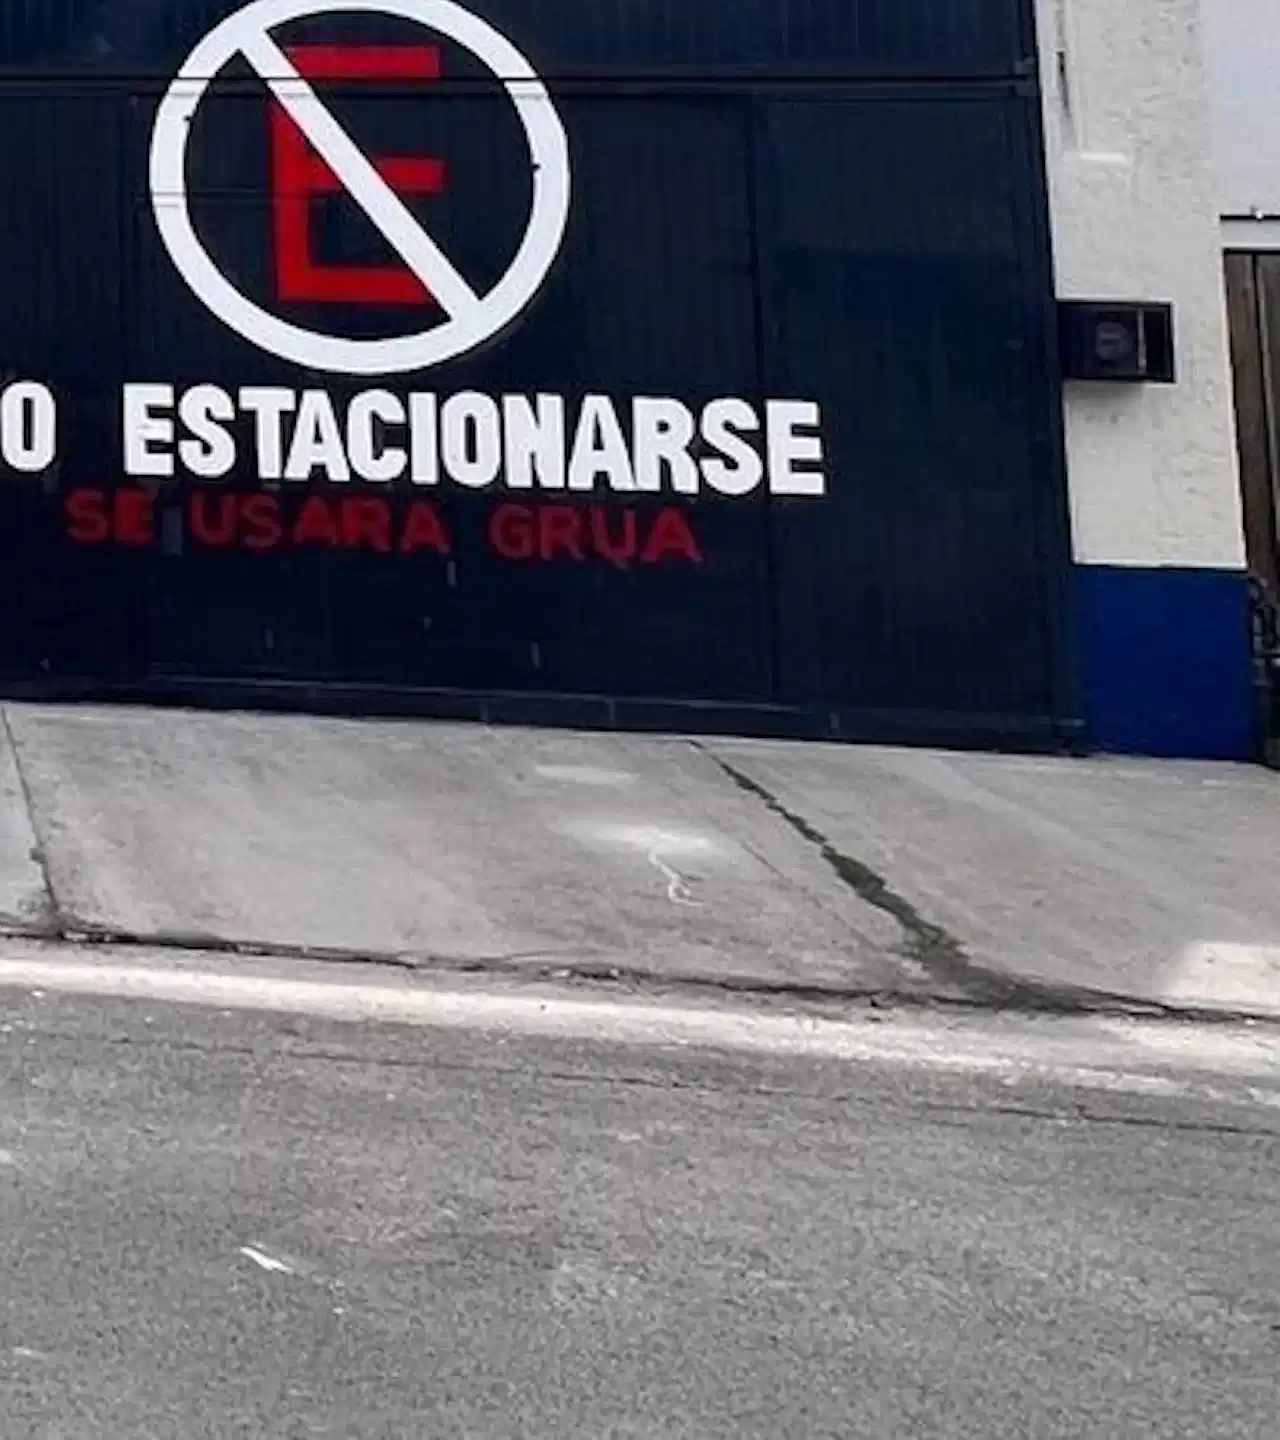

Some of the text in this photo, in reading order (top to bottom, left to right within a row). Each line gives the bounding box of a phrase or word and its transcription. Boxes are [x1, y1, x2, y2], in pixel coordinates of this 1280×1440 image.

[270, 45, 445, 303] E
[122, 384, 825, 495] ESTACIONARSE
[64, 490, 703, 563] SE USARA GRUA
